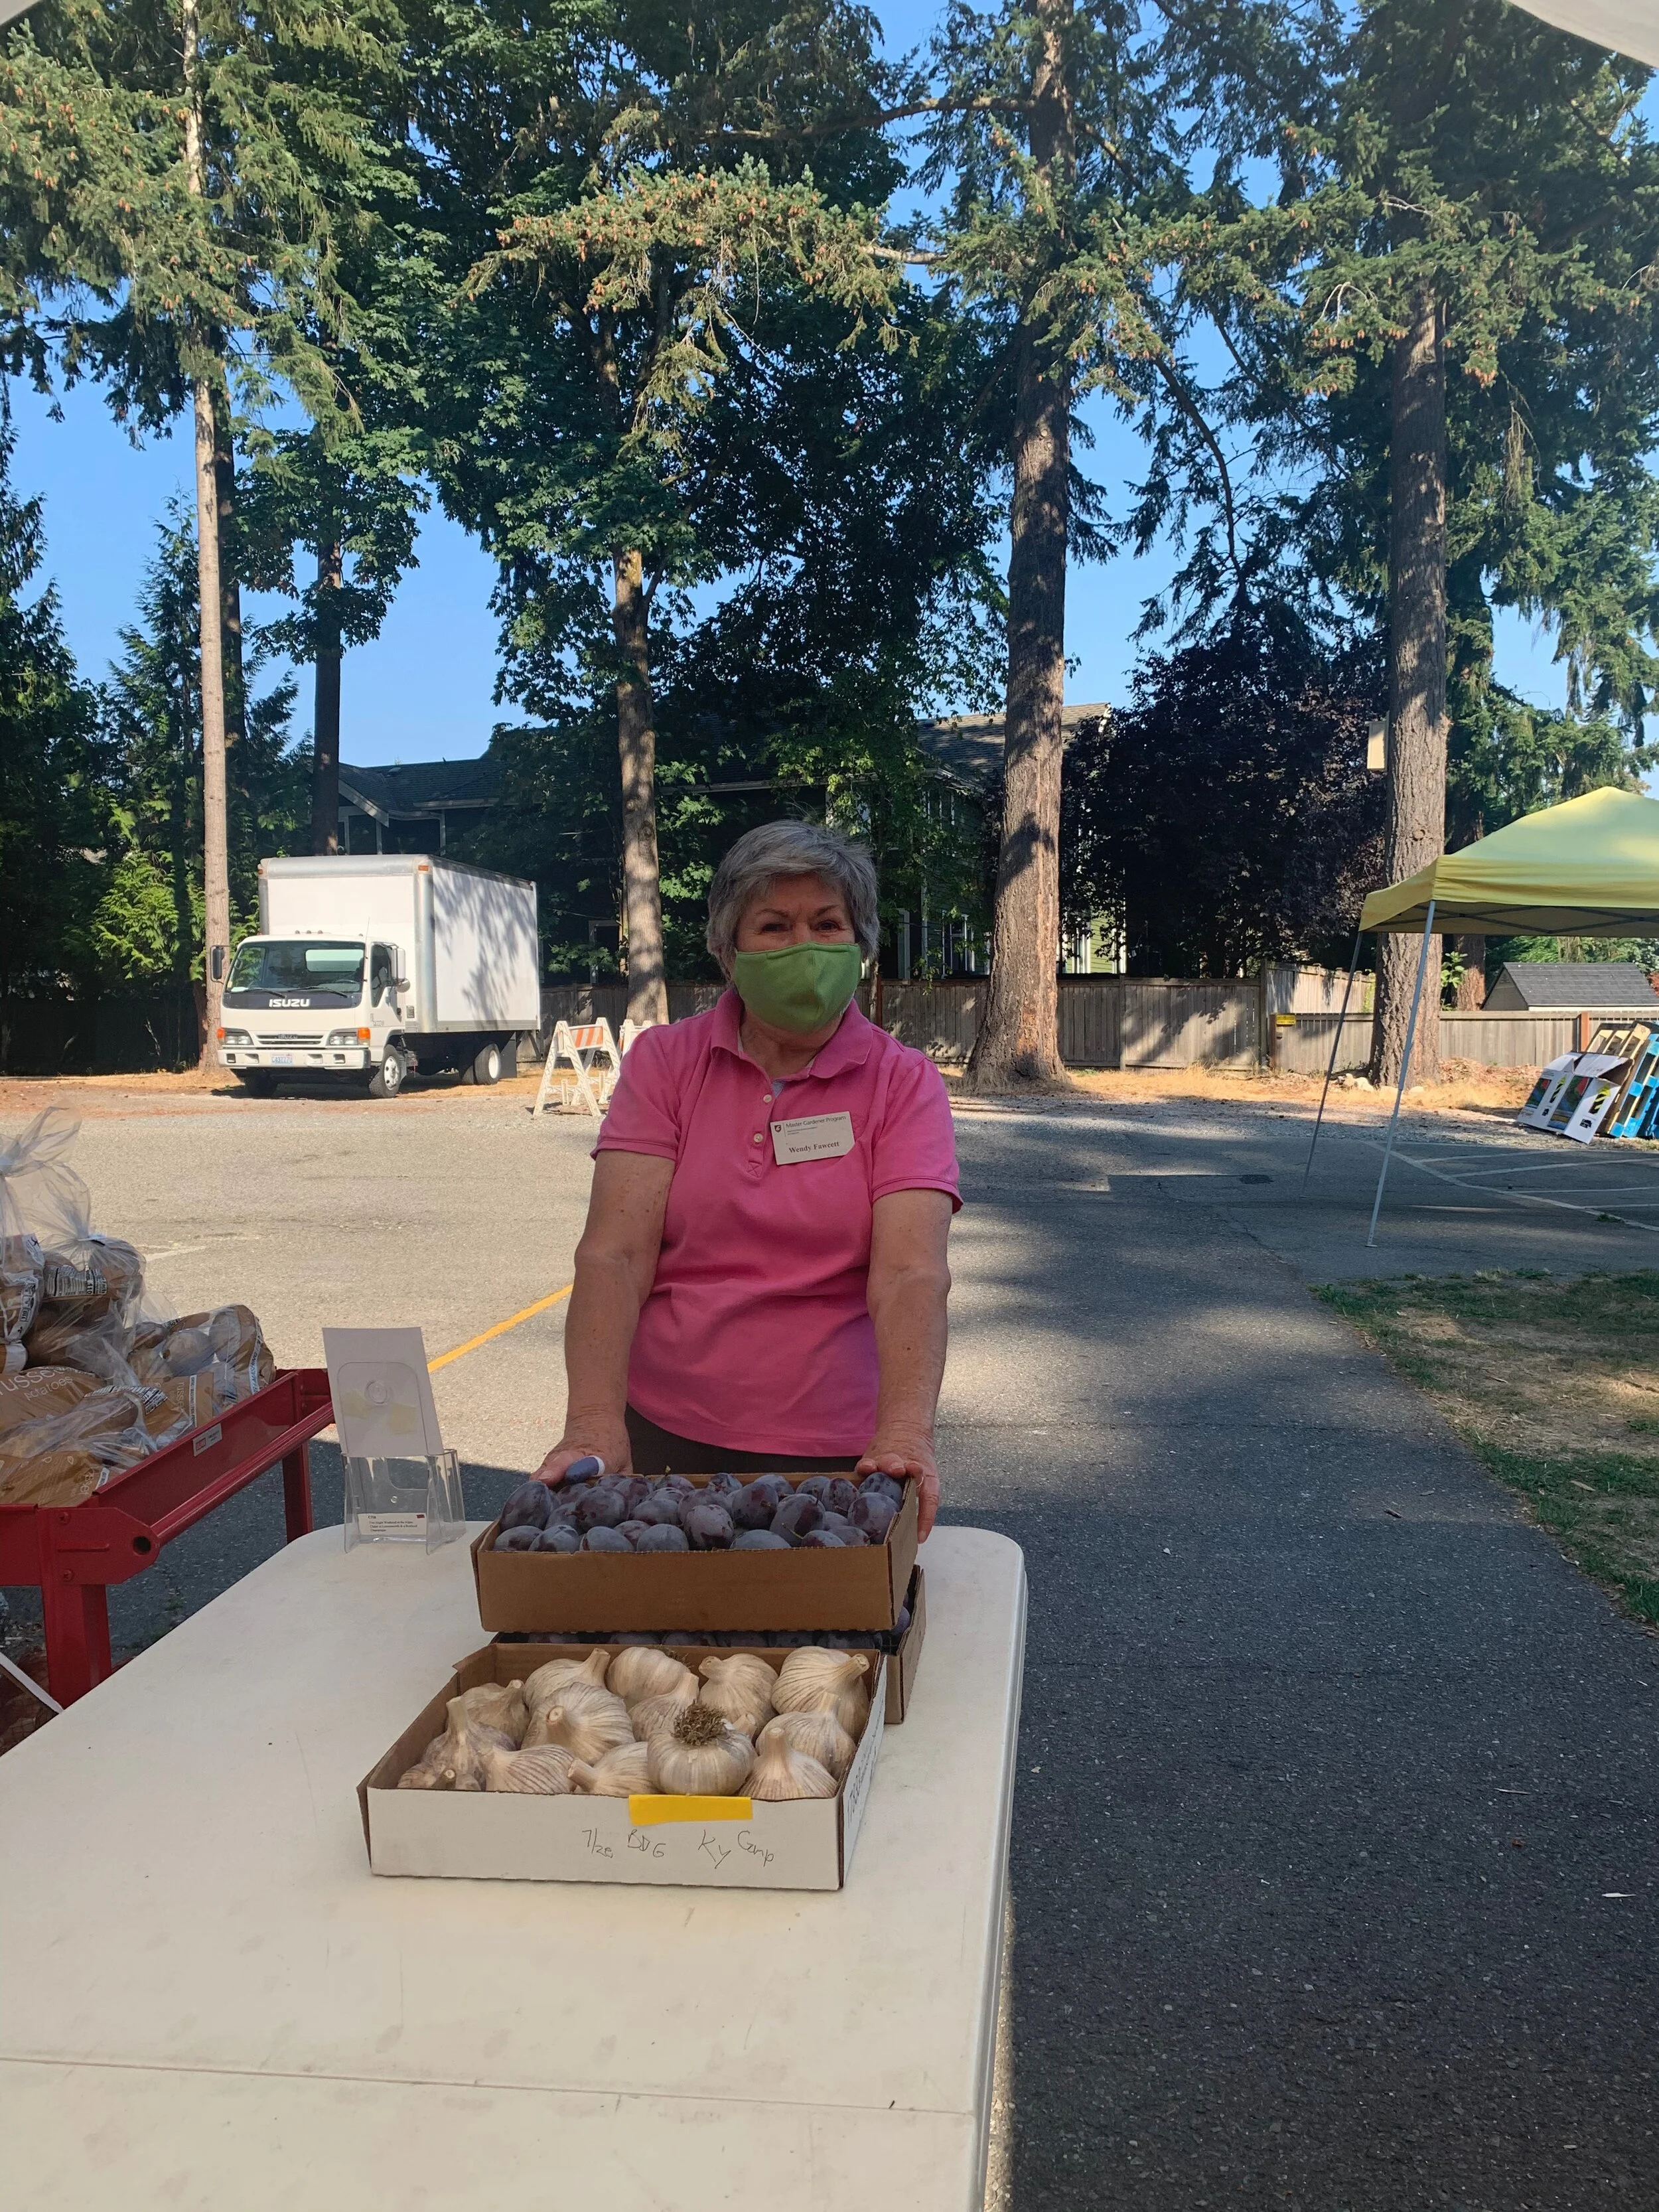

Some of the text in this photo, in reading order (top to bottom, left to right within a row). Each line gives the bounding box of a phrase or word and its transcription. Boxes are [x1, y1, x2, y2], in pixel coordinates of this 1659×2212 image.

[269, 998, 311, 1008] ISUZU
[826, 1115, 846, 1124] Program
[788, 1141, 840, 1153] Wendy Fawcett
[24, 1376, 74, 1401] potatoes
[176, 1382, 185, 1409] russe
